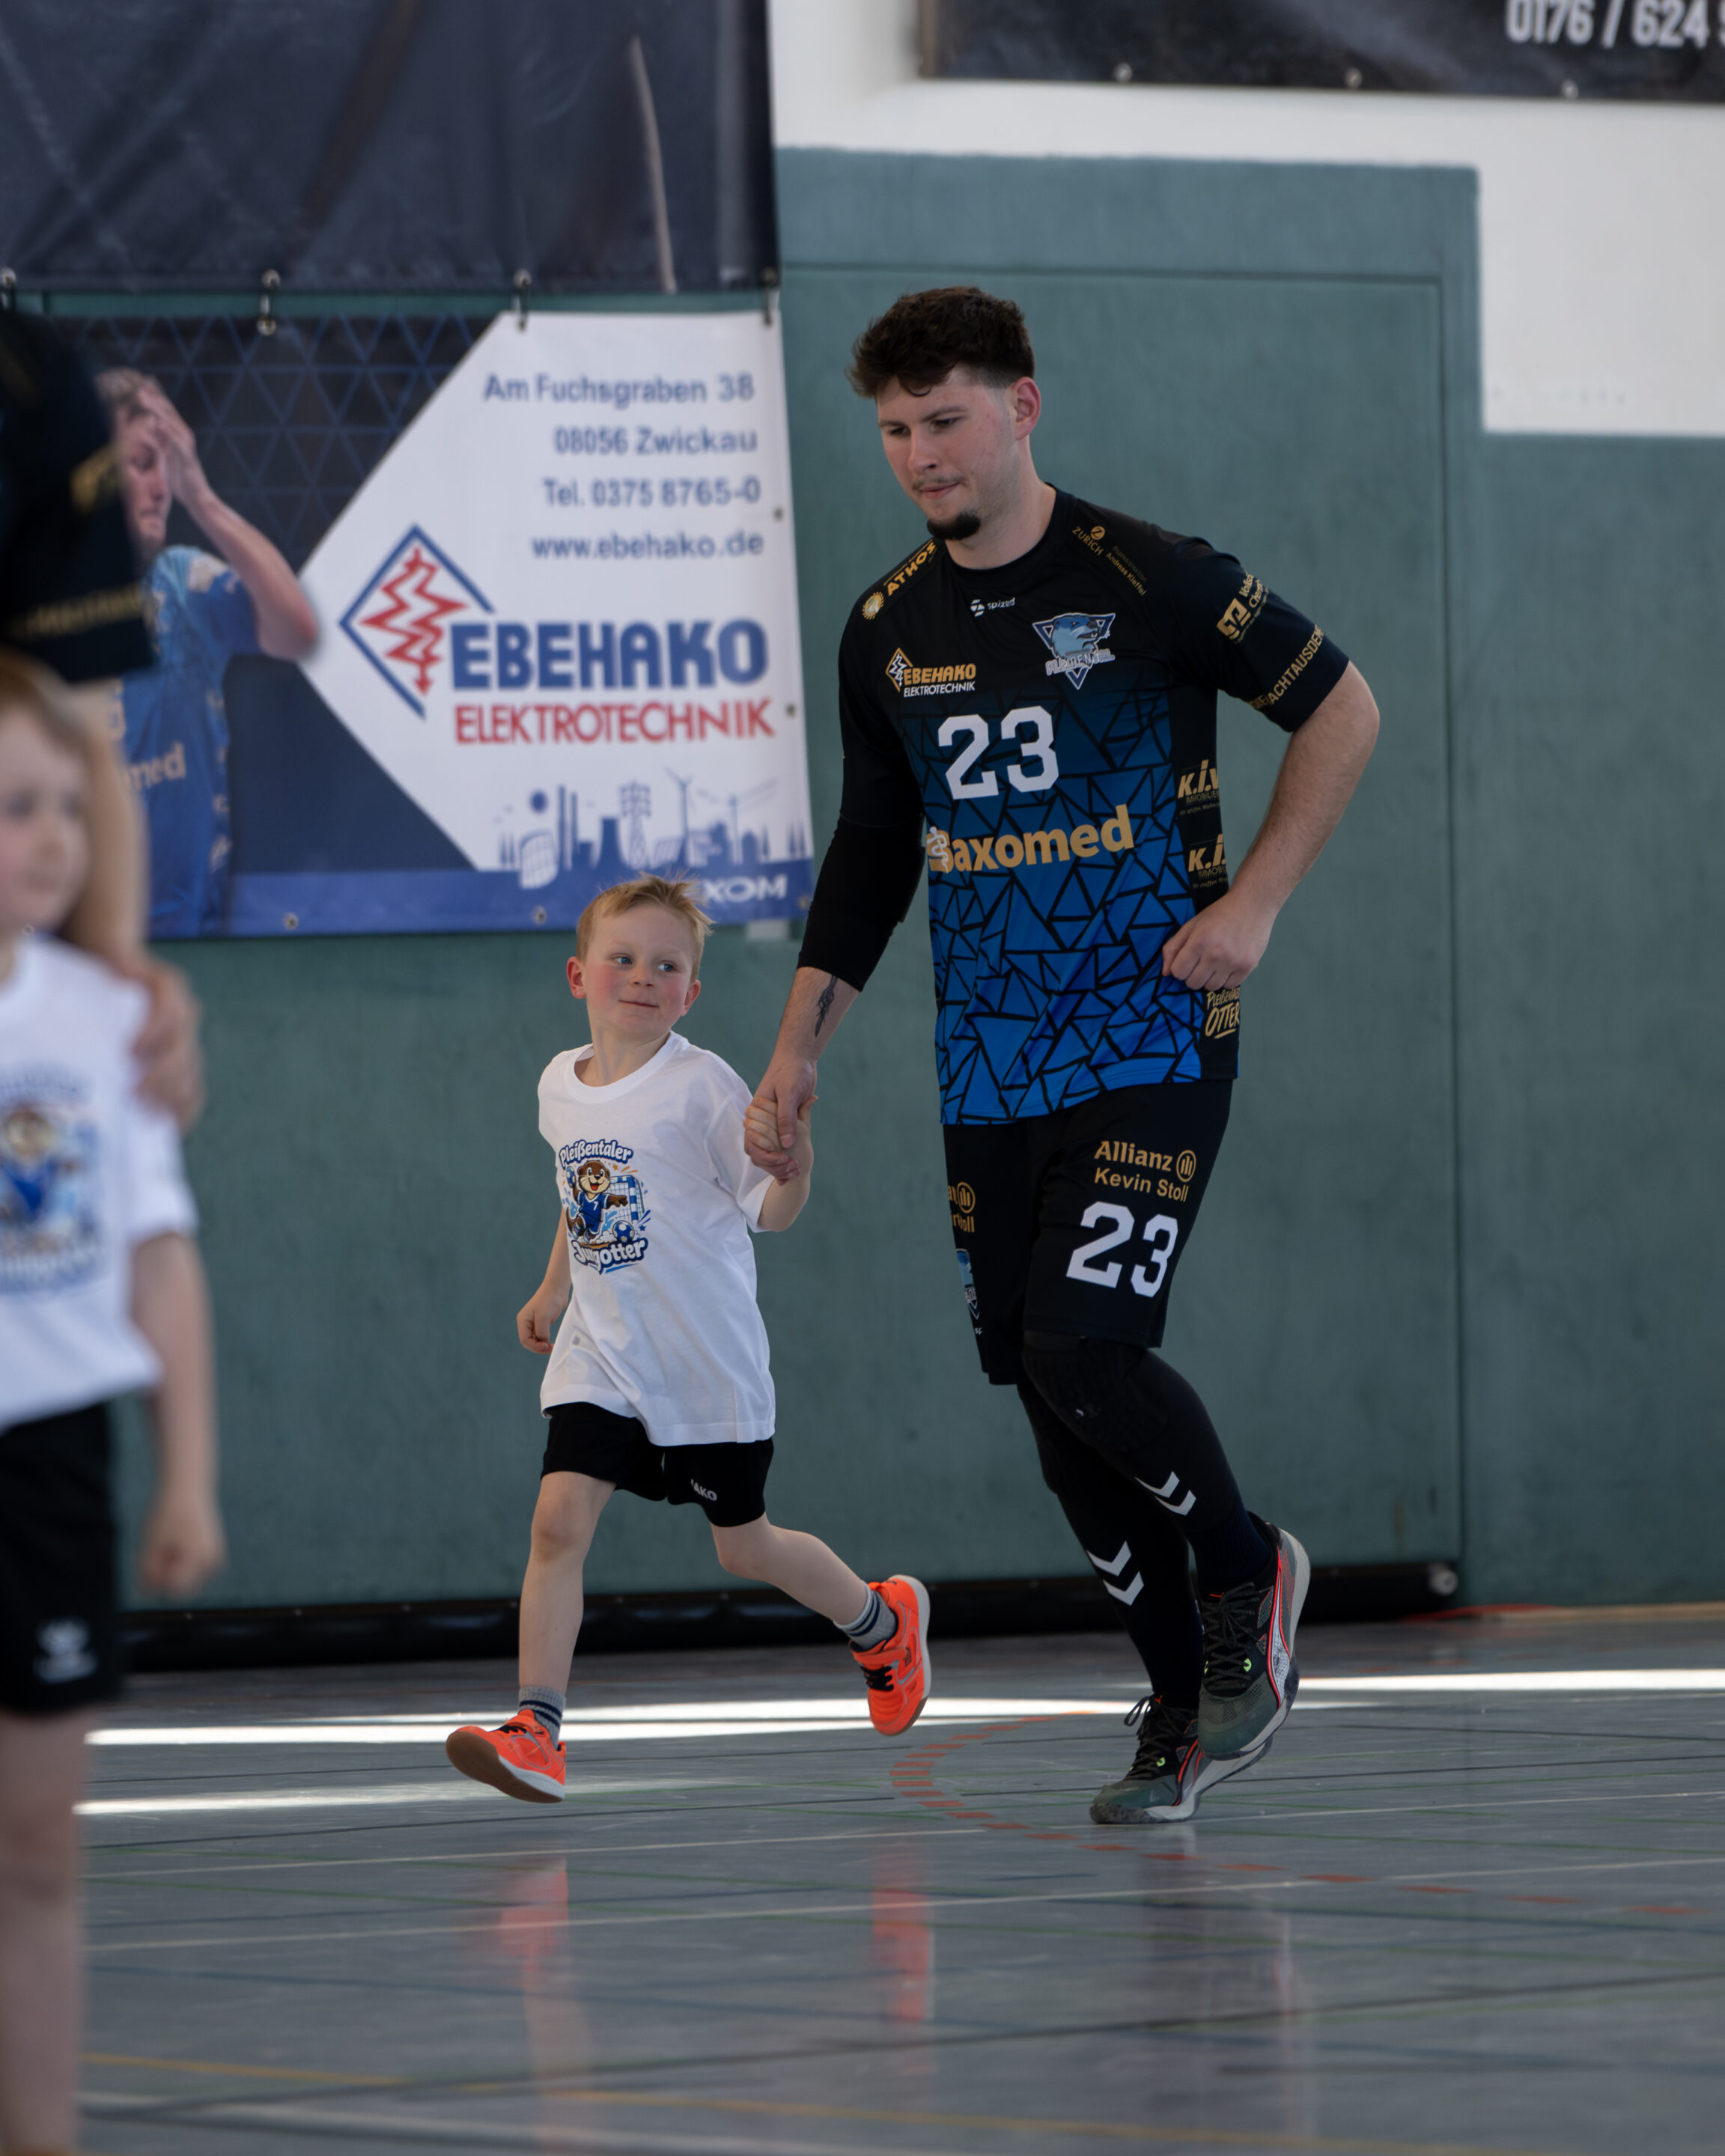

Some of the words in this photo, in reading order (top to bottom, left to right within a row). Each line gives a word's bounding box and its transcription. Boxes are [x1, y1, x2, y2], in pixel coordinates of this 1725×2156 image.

[1506, 0, 1595, 43] 0176
[483, 374, 529, 403] Am
[536, 375, 707, 409] Fuchsgraben
[717, 372, 755, 402] 38
[554, 425, 629, 455] 08056
[635, 425, 758, 455] Zwickau
[544, 478, 585, 507] Tel.
[591, 478, 654, 508] 0375
[660, 475, 762, 508] 8765-0
[532, 530, 764, 559] www.ebehako.de
[1072, 526, 1104, 556] ZURICH
[886, 538, 937, 597] ATHOS
[987, 597, 1016, 611] spized
[450, 618, 769, 692] EBEHAKO
[904, 663, 976, 686] EBEHAKO
[904, 680, 976, 698] ELEKTROTECHNIK
[455, 696, 776, 745] ELEKTROTECHNIK
[937, 705, 1059, 800] 23
[1205, 1001, 1241, 1036] OTTER
[559, 1139, 633, 1169] Pleißentaler
[1095, 1140, 1173, 1172] Allianz
[1095, 1167, 1151, 1194] Kevin
[1157, 1178, 1189, 1202] Stoll
[1066, 1201, 1178, 1298] 23
